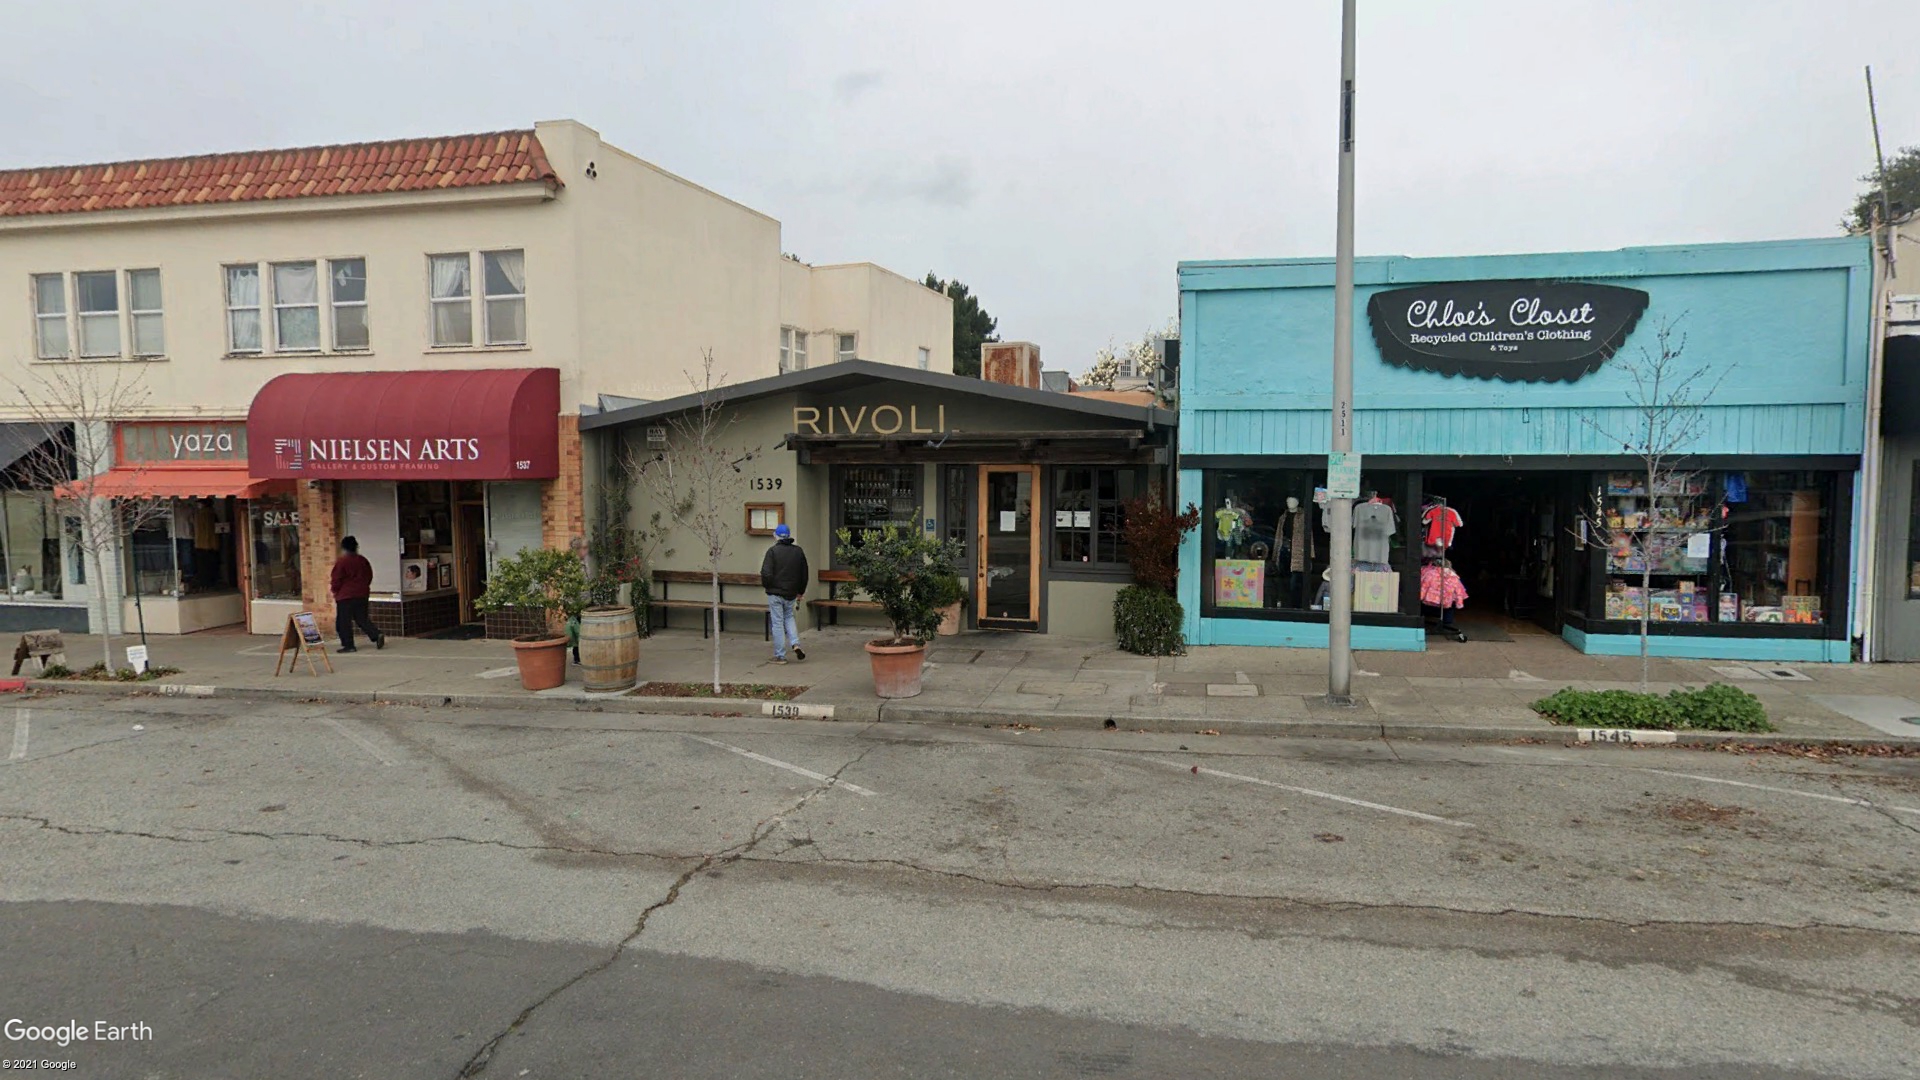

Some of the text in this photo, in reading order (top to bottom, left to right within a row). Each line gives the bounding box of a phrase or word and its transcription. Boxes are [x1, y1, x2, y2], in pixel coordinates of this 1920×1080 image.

[1406, 296, 1596, 330] Chloe's Closet
[1410, 328, 1592, 345] Recycled Children's Clothing
[1498, 344, 1518, 352] Toys
[792, 404, 945, 435] RIVOLI
[169, 432, 233, 459] yaza
[309, 438, 480, 462] NIELSEN ARTS
[515, 460, 531, 470] 1537
[750, 477, 783, 491] 1539
[263, 511, 301, 526] SALE
[771, 704, 800, 717] 1539
[1590, 729, 1633, 743] 1545
